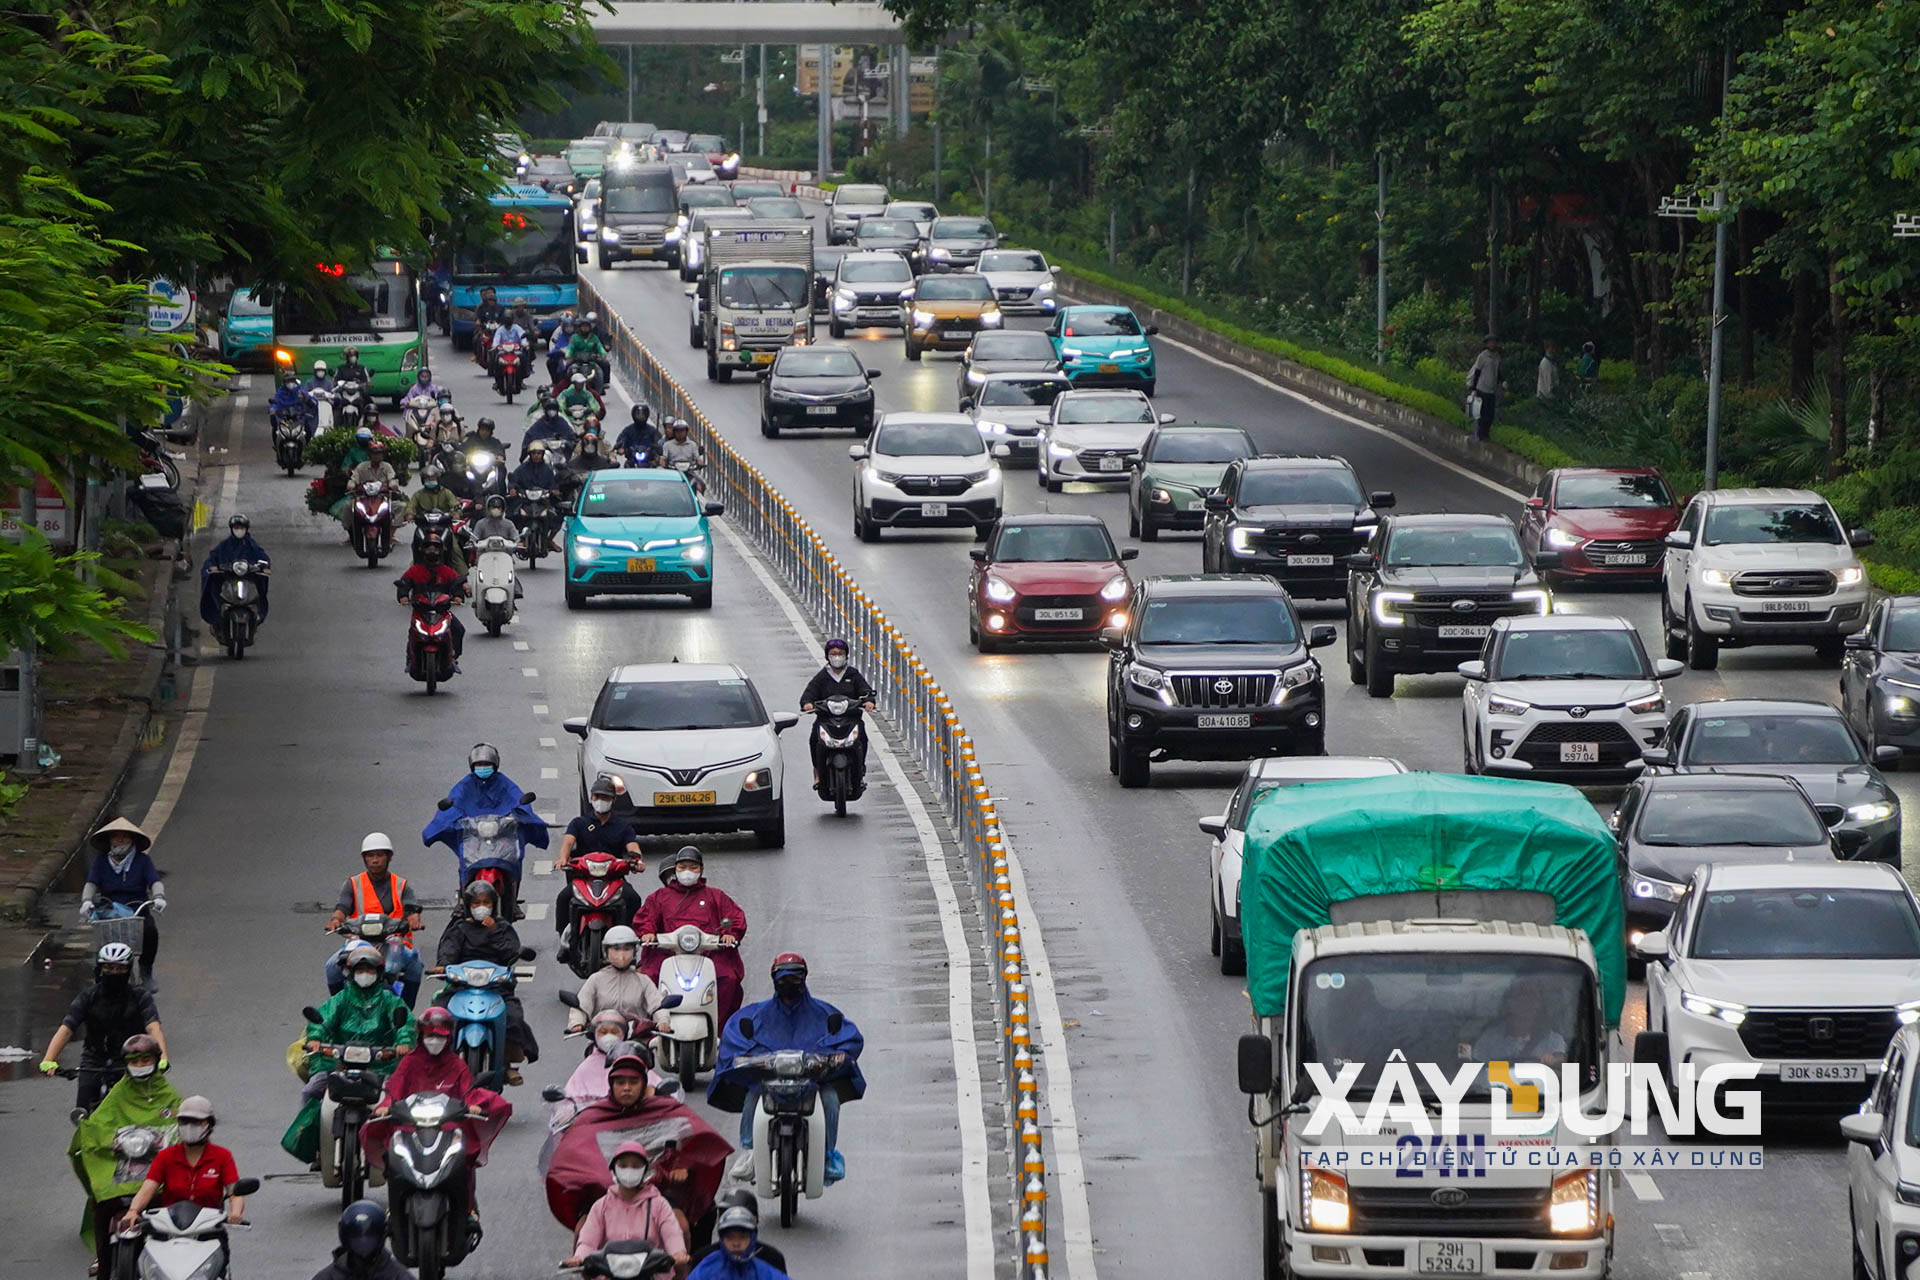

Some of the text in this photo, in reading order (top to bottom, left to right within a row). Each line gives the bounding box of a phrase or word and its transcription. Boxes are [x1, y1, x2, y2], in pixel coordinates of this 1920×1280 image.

[43, 519, 60, 531] 86
[1199, 716, 1250, 727] 30A-410.85
[1571, 743, 1588, 753] 99A
[1787, 1066, 1858, 1079] 30K-849.37
[1395, 1133, 1486, 1178] 24H
[1437, 1242, 1464, 1256] 29H
[1425, 1256, 1475, 1271] 529.43
